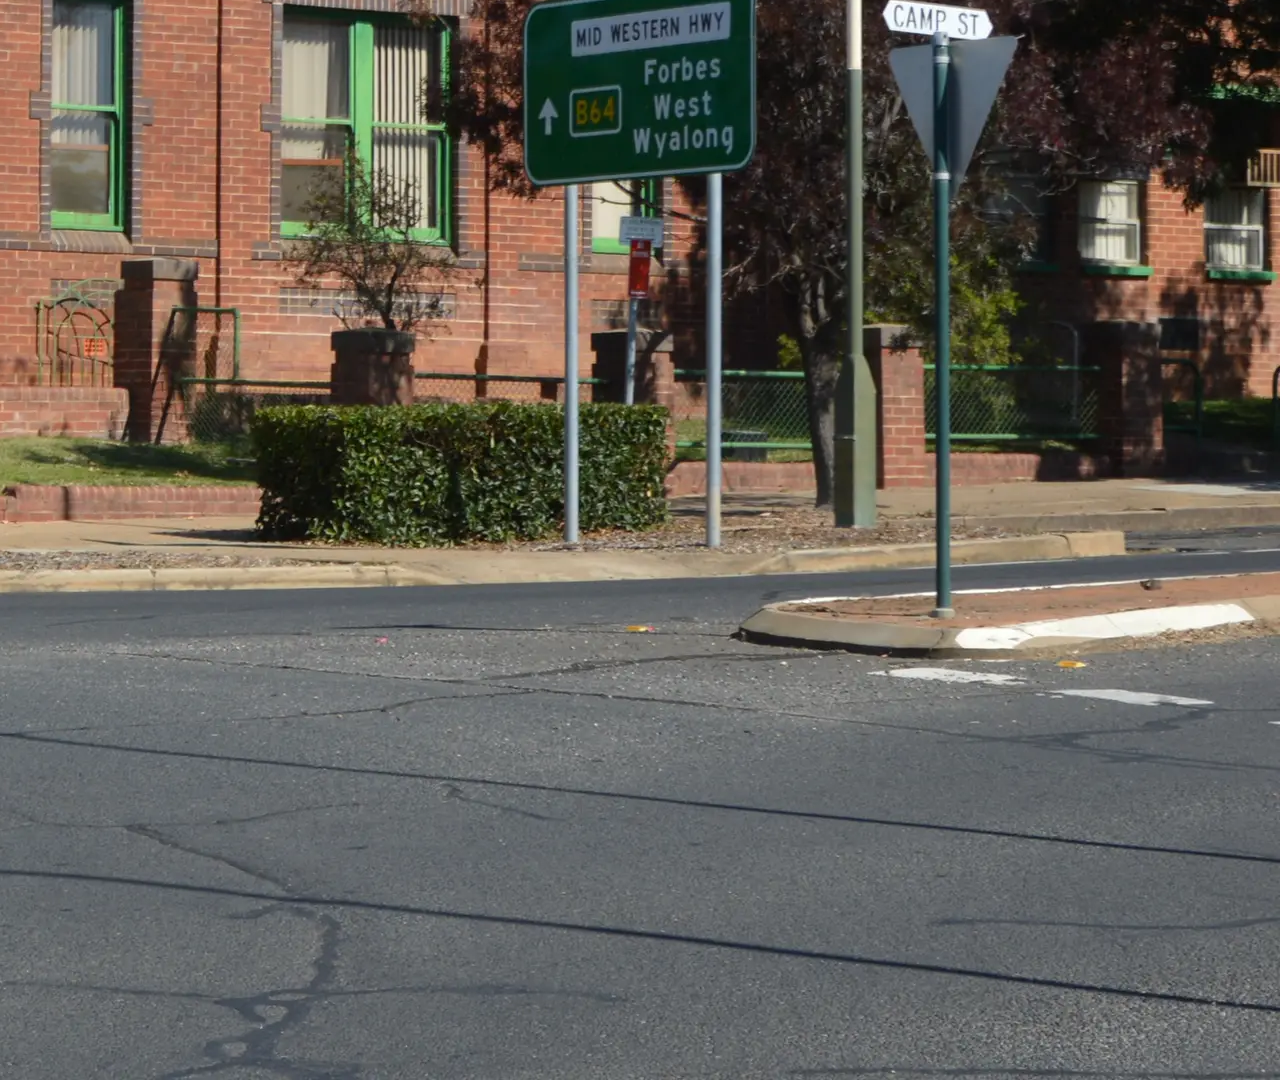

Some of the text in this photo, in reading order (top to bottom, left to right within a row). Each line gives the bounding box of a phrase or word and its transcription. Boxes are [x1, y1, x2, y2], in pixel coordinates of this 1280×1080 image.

[575, 11, 725, 48] MID WESTERN HWY
[893, 4, 980, 37] CAMP ST
[643, 56, 722, 86] Forbes
[575, 96, 617, 125] B64
[653, 90, 713, 121] West
[632, 124, 735, 159] Wyalong
